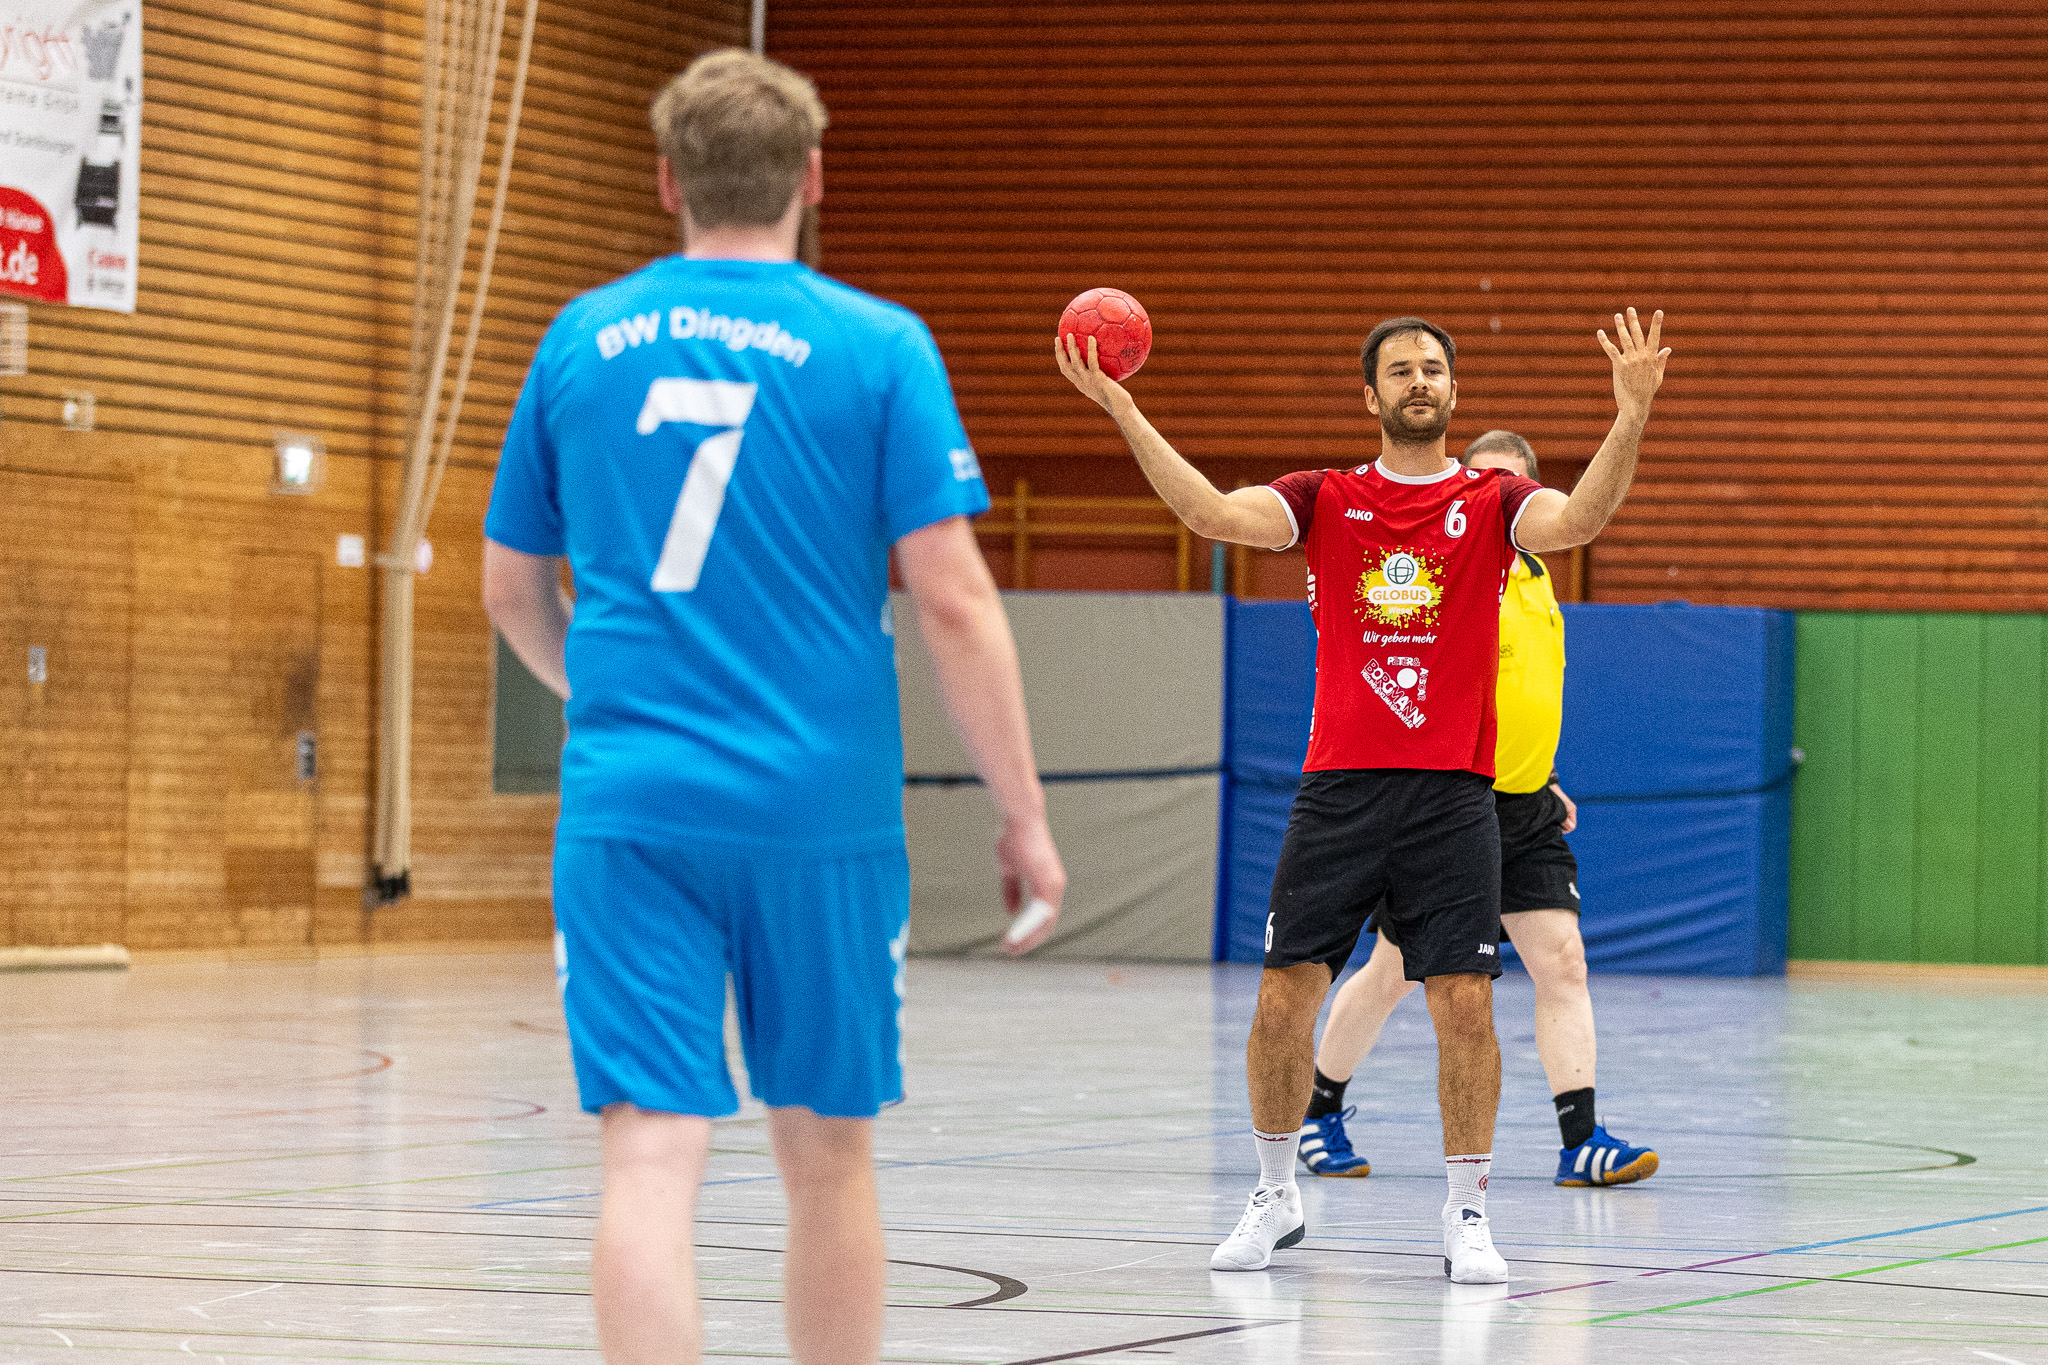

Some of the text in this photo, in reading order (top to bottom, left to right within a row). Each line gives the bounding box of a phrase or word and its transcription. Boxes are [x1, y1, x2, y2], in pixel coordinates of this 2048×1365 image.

[596, 306, 812, 368] BW Dingden
[636, 377, 758, 593] 7
[1344, 508, 1374, 522] JAKO
[1444, 500, 1467, 539] 6
[1372, 590, 1427, 601] GLOBUS
[1363, 631, 1438, 647] Wir geben mehr
[1364, 658, 1424, 725] BORGMANN
[1264, 911, 1276, 953] 6
